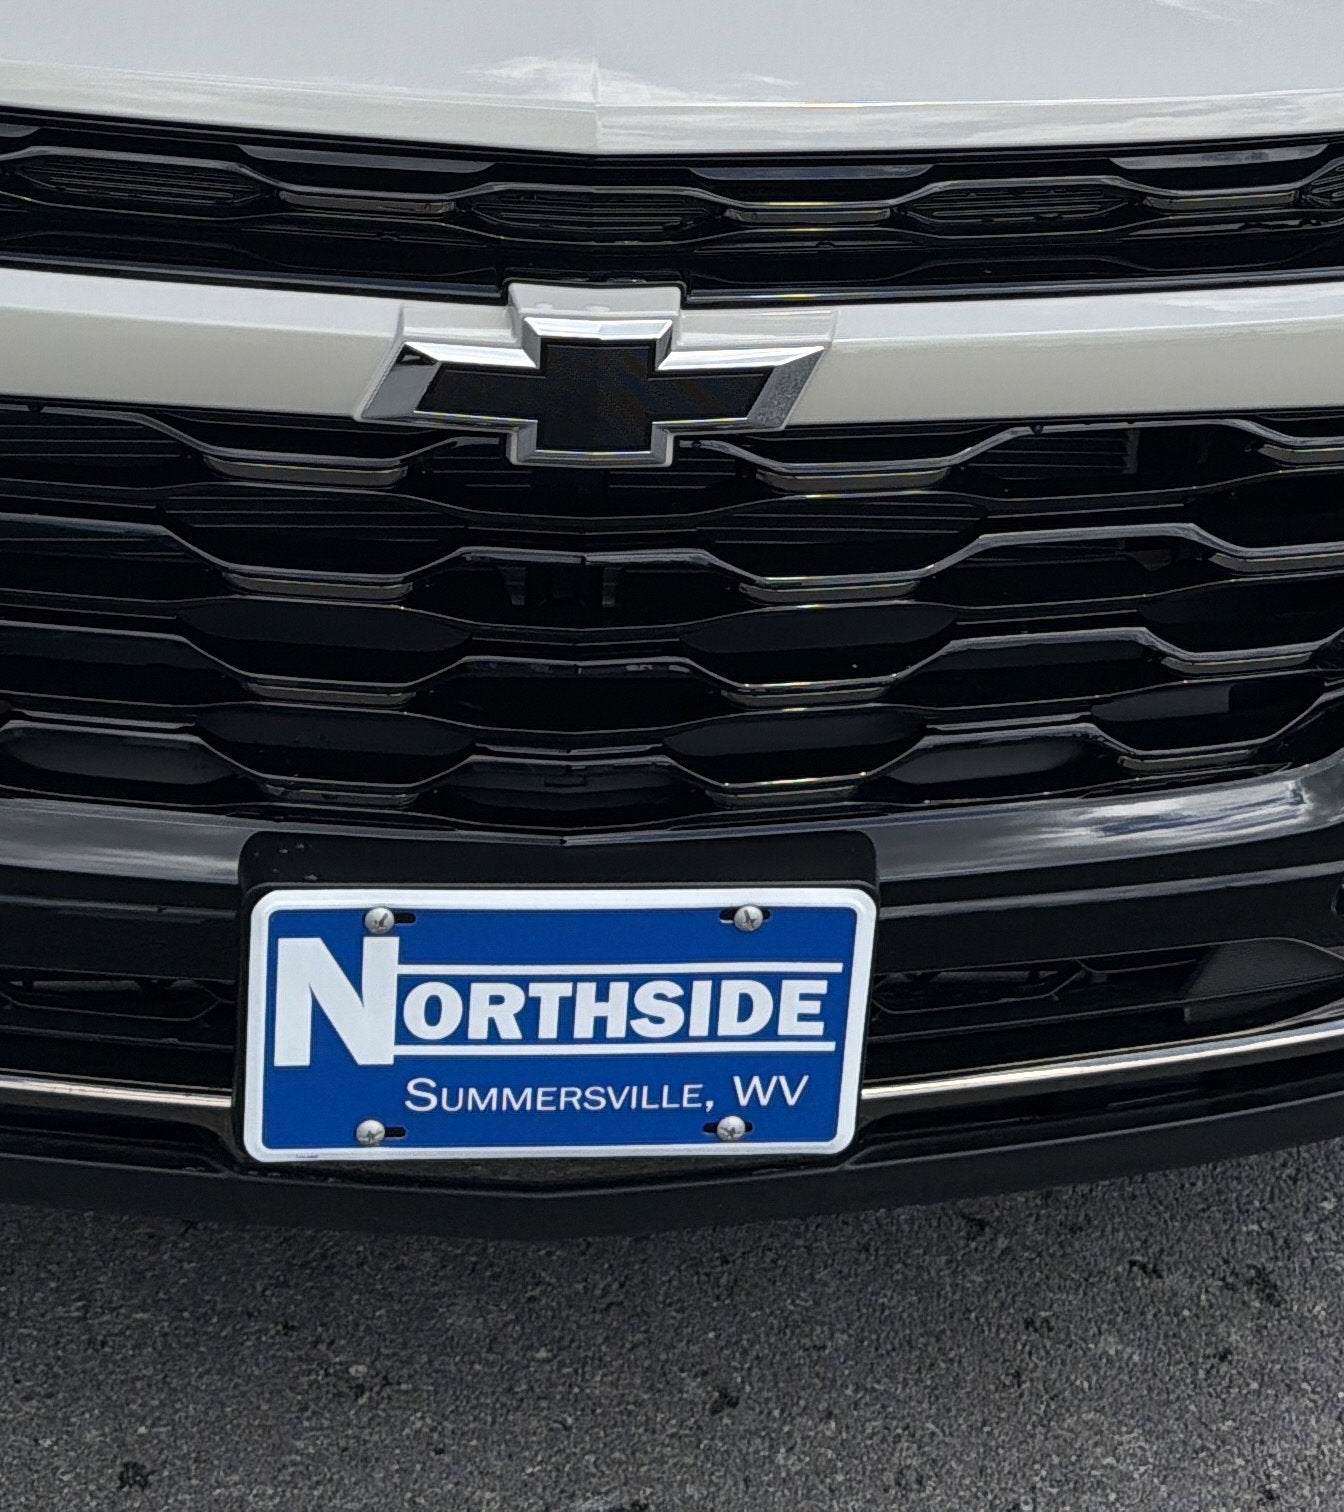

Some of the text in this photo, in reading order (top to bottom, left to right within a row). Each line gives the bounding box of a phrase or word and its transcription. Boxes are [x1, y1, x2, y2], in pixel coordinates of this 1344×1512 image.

[273, 935, 829, 1067] NORTHSIDE
[404, 1074, 810, 1114] SUMMERSVILLE, WV
